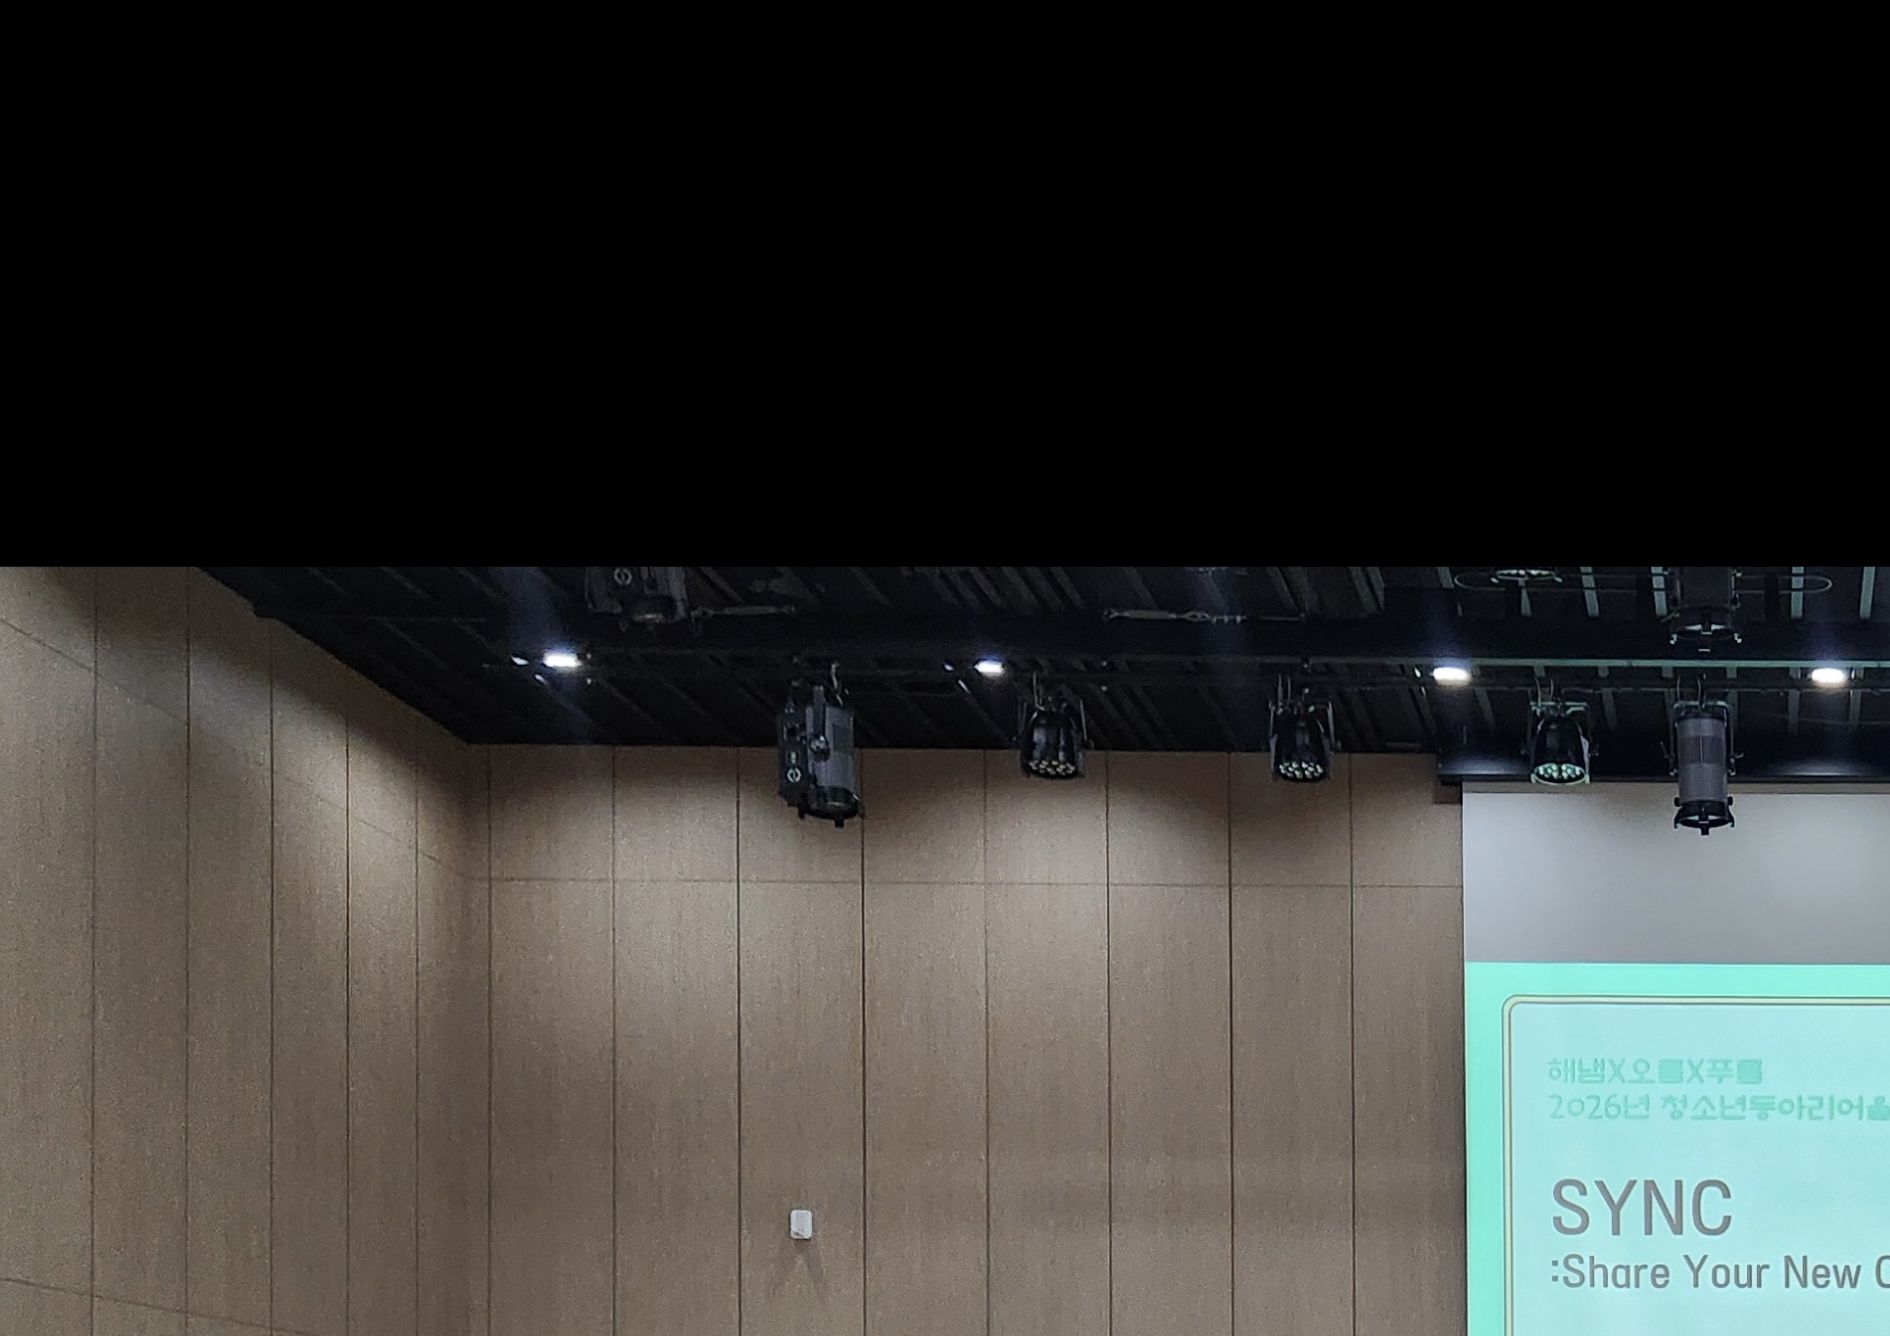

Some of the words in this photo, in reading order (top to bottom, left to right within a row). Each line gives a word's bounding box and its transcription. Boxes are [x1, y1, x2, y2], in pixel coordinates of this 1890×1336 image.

[1547, 1093, 1651, 1121] 2026년
[1552, 1178, 1732, 1236] SYNC
[1683, 1254, 1770, 1289] Your
[1784, 1255, 1862, 1289] New
